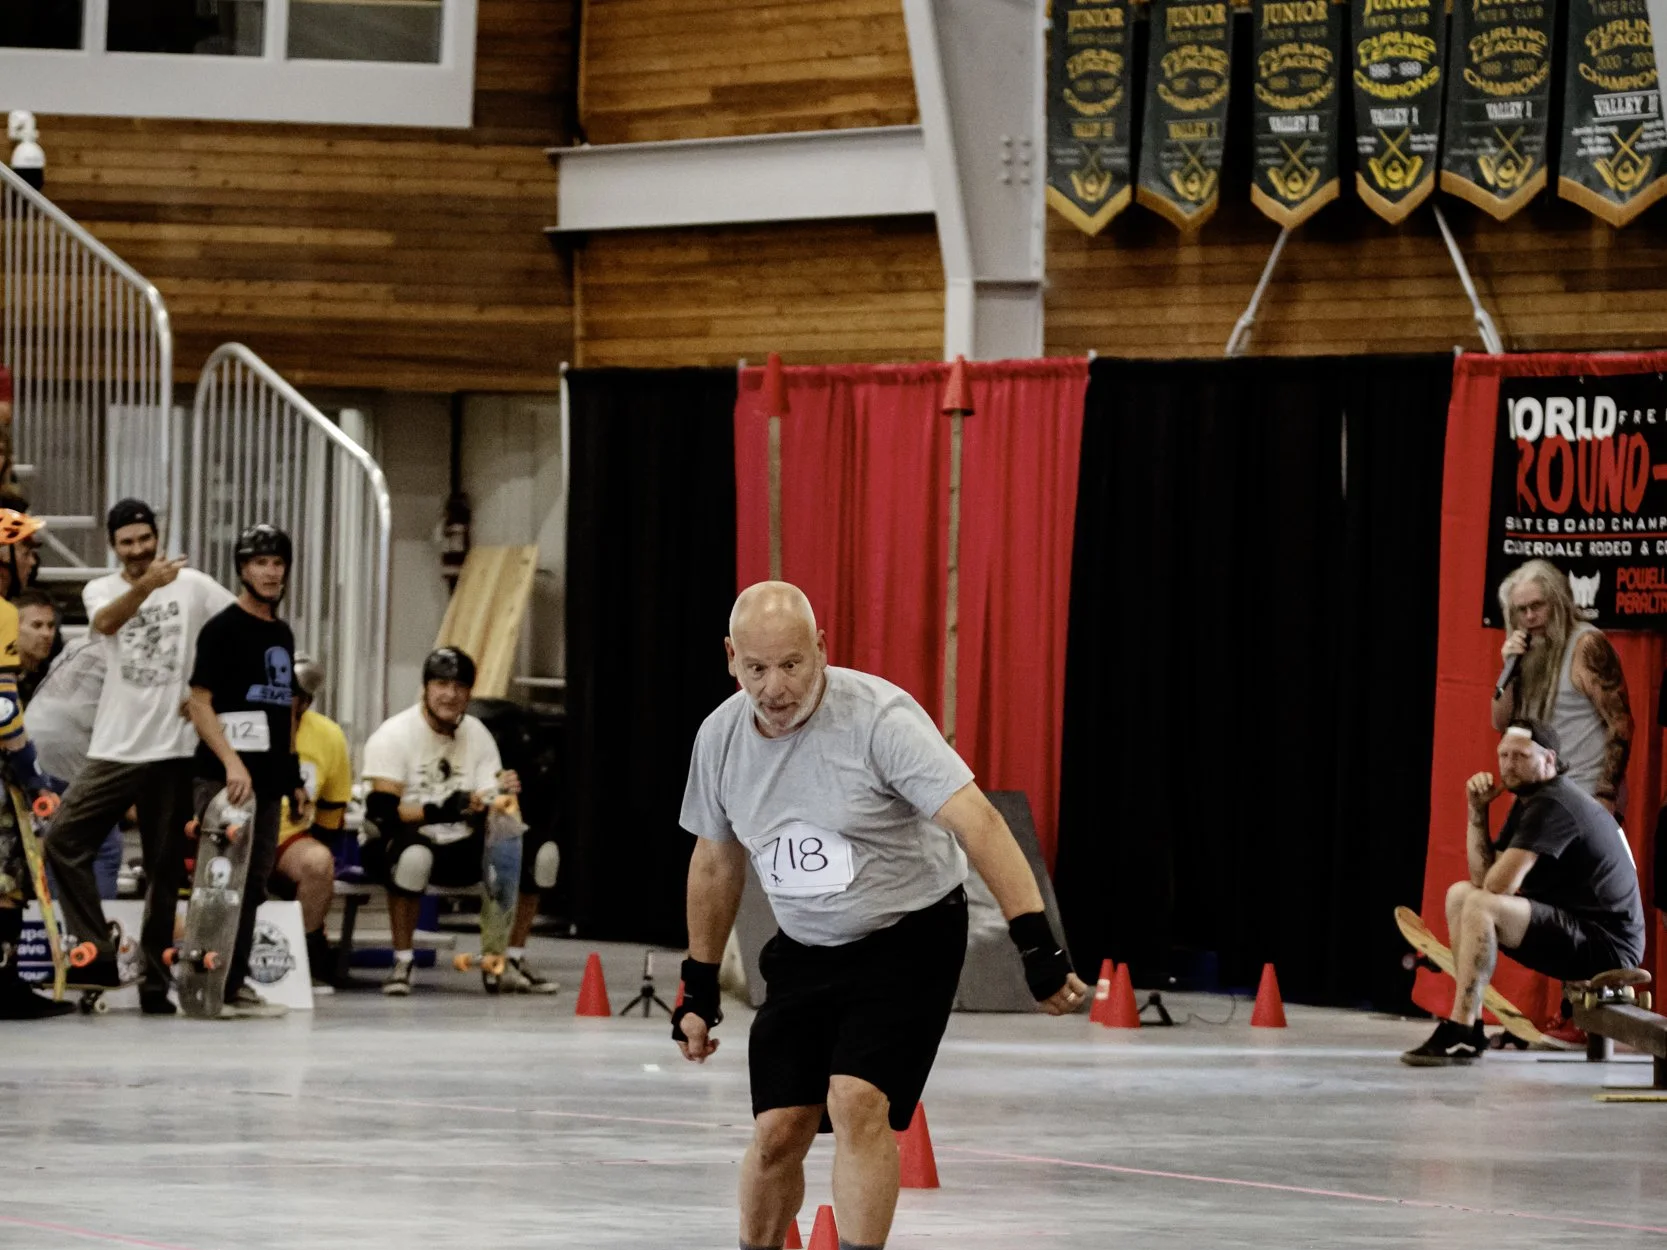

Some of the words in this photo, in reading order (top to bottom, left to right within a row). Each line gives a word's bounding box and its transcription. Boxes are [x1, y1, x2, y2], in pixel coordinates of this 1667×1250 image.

[1262, 1, 1328, 28] JUNIOR
[1469, 26, 1548, 52] CURLING
[1472, 39, 1544, 64] LEAGUE
[1578, 63, 1658, 91] CHAMPION
[1594, 96, 1643, 117] VALLEY
[1508, 396, 1617, 441] ORLD
[1589, 541, 1632, 556] RODEO
[1640, 541, 1649, 556] &
[762, 837, 828, 872] 718
[17, 944, 46, 956] ave
